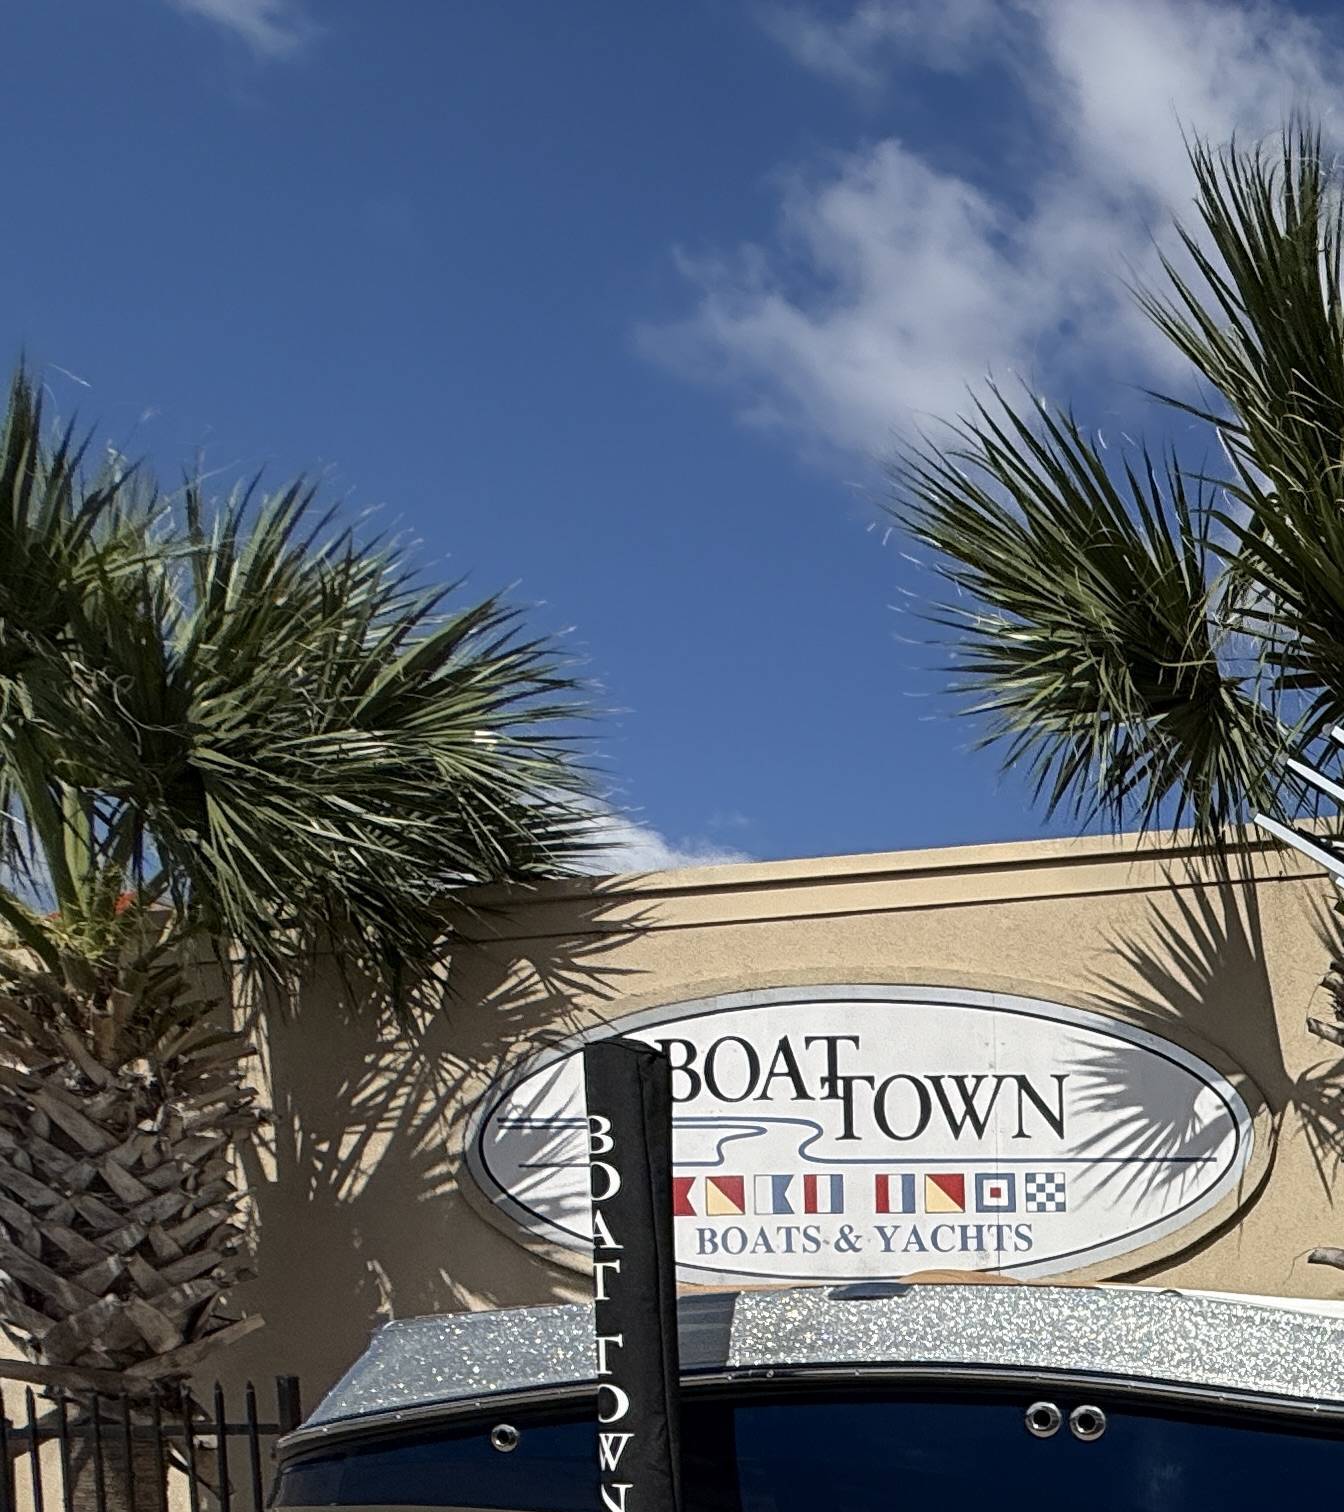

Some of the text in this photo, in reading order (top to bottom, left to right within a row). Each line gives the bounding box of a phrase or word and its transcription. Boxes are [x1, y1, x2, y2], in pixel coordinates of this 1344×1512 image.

[655, 1035, 1070, 1141] BOAT TOWN
[696, 1222, 1034, 1256] BOATS & YACHTS
